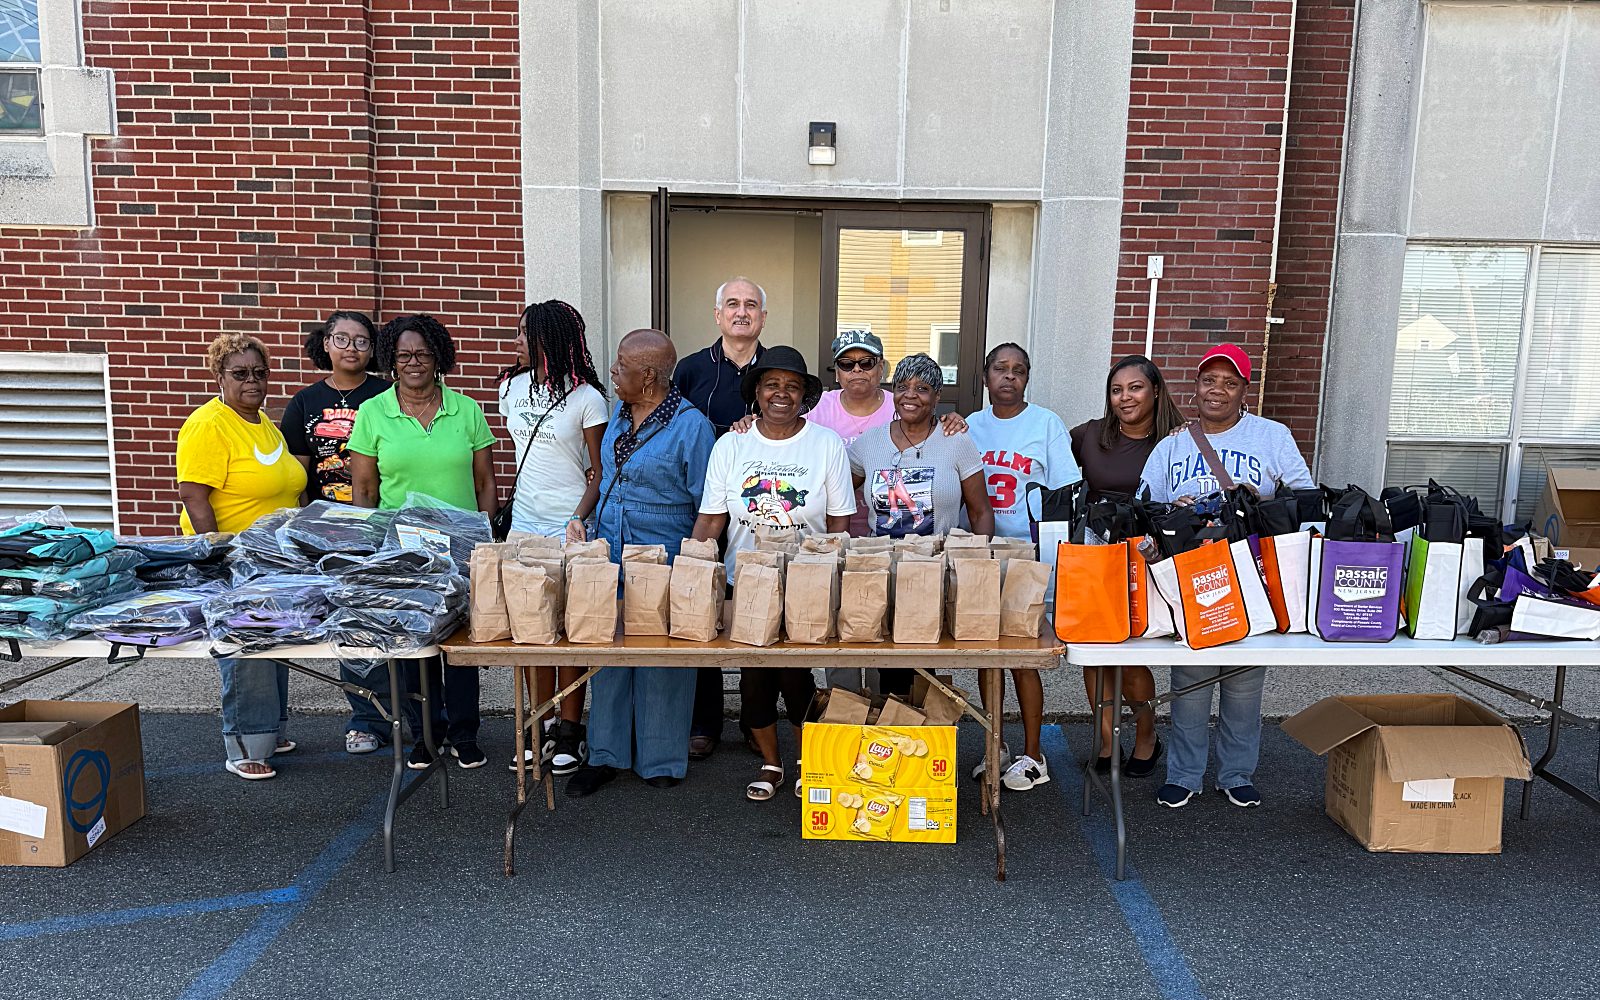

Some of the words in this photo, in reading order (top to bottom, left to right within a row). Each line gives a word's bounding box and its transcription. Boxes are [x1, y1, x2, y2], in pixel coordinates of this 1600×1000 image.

[840, 330, 869, 348] NY
[514, 398, 528, 408] LOS
[529, 399, 565, 412] ANGEES
[514, 428, 557, 440] CALIORNIA
[979, 450, 1033, 475] ALM
[1193, 565, 1229, 588] passaic
[1336, 567, 1388, 580] passaic
[1197, 577, 1230, 593] COUNTY
[1338, 577, 1386, 588] COUNTY
[932, 759, 947, 772] 50
[1437, 801, 1457, 809] CHINA
[811, 811, 829, 826] 50
